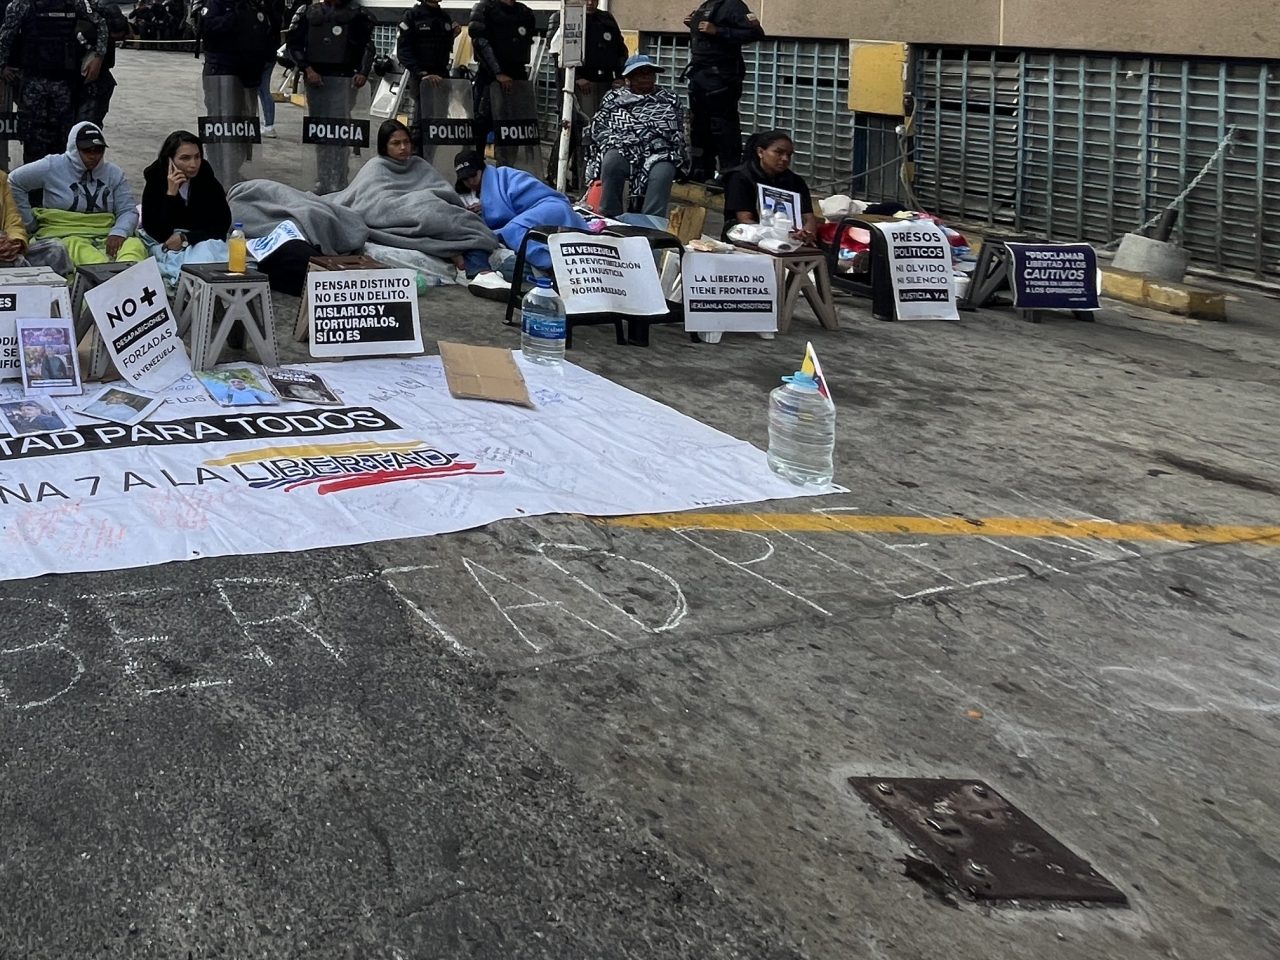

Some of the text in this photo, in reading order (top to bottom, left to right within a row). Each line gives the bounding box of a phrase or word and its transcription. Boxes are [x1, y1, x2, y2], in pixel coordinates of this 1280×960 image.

[205, 120, 256, 137] POLICÍA
[308, 122, 363, 140] POLICÍA
[892, 232, 941, 242] PRESOS
[562, 246, 576, 254] EN
[894, 247, 943, 257] POLÍTICOS
[1026, 260, 1063, 268] LIBERTAD
[1072, 261, 1086, 269] LOS
[589, 267, 624, 278] INJUSTICIA
[694, 274, 765, 283] LA LIBERTAD NO
[1024, 269, 1085, 280] CAUTIVOS
[315, 278, 410, 290] PENSAR DISTINTO
[315, 290, 409, 303] NO ES UN DELITO.
[572, 287, 627, 297] NORMALIZADO
[690, 287, 716, 295] TIENE
[106, 298, 137, 329] NO
[315, 305, 385, 318] AISLARLOS Y
[315, 317, 400, 330] TORTURARLOS,
[116, 312, 166, 349] DESAPARICIONES
[316, 329, 360, 342] SÍ LO ES
[3, 348, 17, 357] SE
[122, 328, 173, 368] FORZADAS
[132, 344, 176, 381] EN VENEZUELA
[94, 421, 227, 445] PARA
[225, 410, 387, 434] TODOS
[74, 475, 101, 498] 7
[124, 471, 157, 492] A
[161, 466, 229, 487] LA
[231, 448, 454, 482] LIBERTAD
